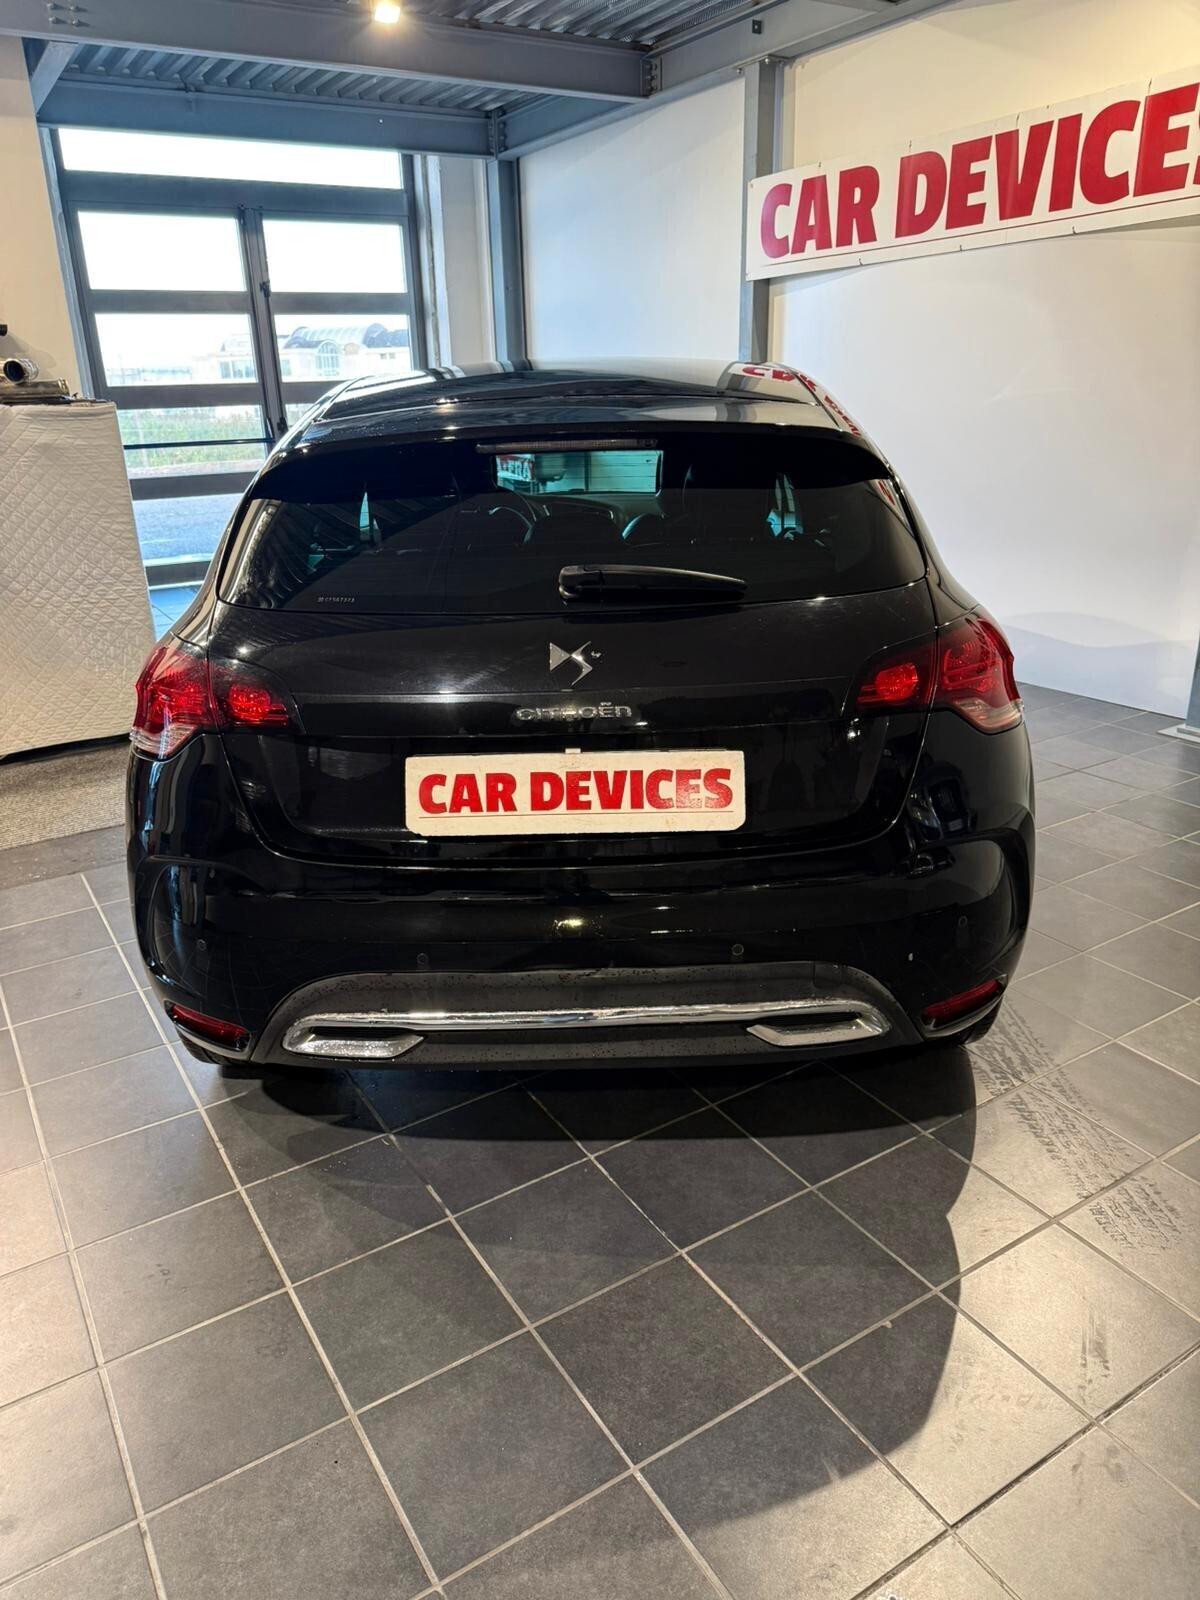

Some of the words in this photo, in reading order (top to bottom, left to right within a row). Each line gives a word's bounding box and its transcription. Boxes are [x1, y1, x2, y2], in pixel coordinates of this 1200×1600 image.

[760, 165, 880, 259] CAR
[895, 82, 1200, 238] DEVICE
[418, 772, 517, 813] CAR
[530, 768, 733, 812] DEVICES
